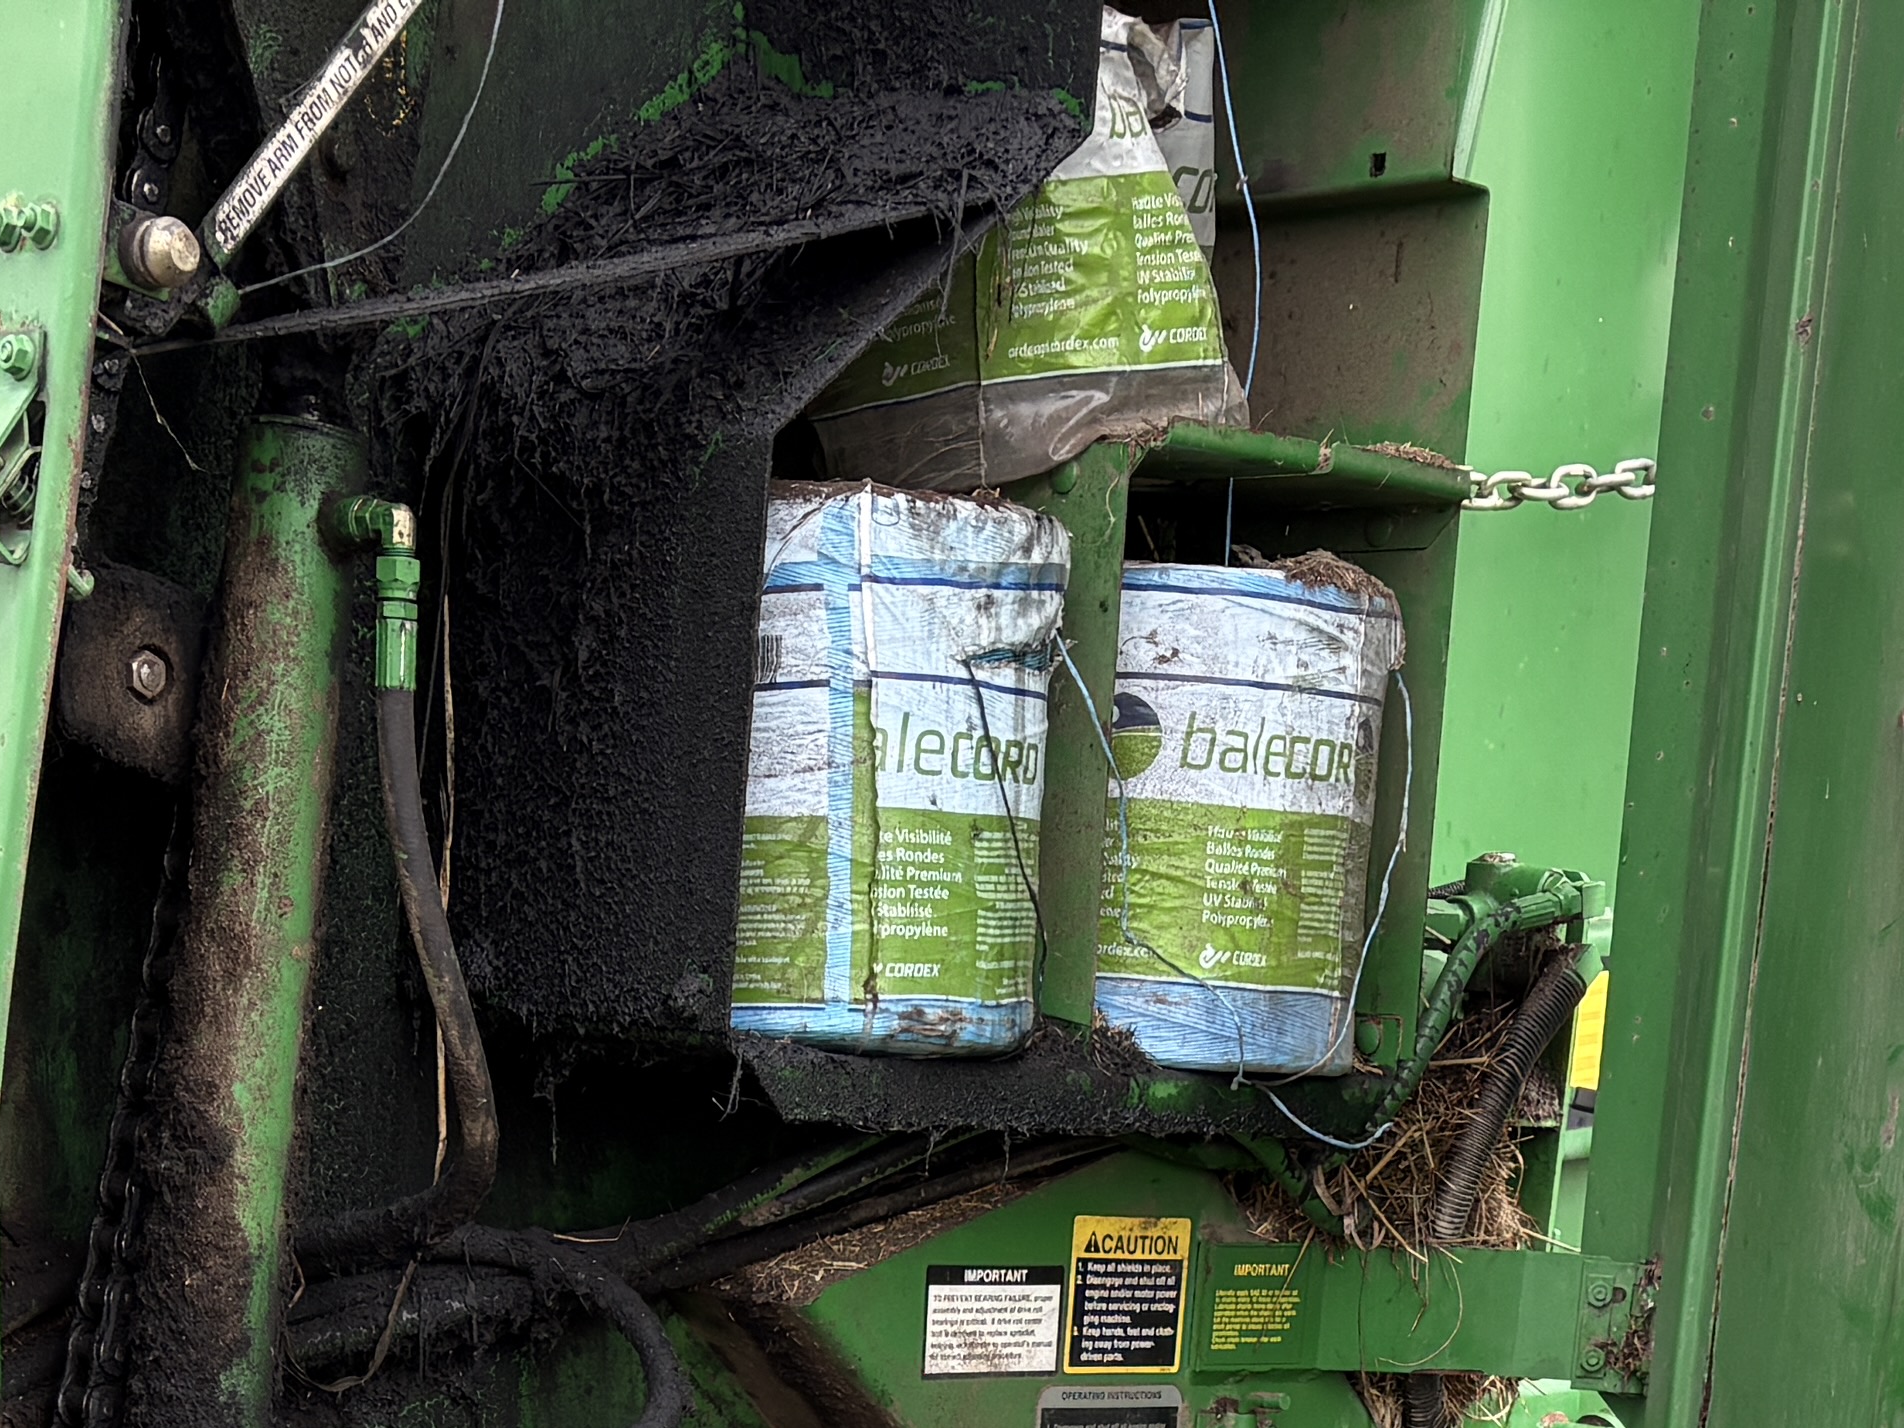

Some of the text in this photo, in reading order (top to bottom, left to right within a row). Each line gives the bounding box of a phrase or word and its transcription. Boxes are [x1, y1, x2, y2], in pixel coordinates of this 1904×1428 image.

[217, 170, 272, 245] REMOVE
[267, 133, 299, 173] ARM
[295, 86, 331, 141] FROM
[370, 5, 398, 42] AND
[896, 827, 953, 845] Visibilité
[896, 847, 945, 864] Rondes
[906, 866, 963, 883] Premium
[1205, 859, 1249, 875] Qualité
[908, 884, 950, 900] Testée
[1203, 892, 1223, 907] UV
[885, 963, 941, 978] CORDEX
[1101, 1233, 1179, 1256] CAUTION
[964, 1269, 1028, 1283] IMPORTANT
[1087, 1262, 1104, 1274] Keep
[1234, 1264, 1290, 1276] IMPORTANT
[1061, 1390, 1162, 1400] OPERATING INSTRUCTIONS
